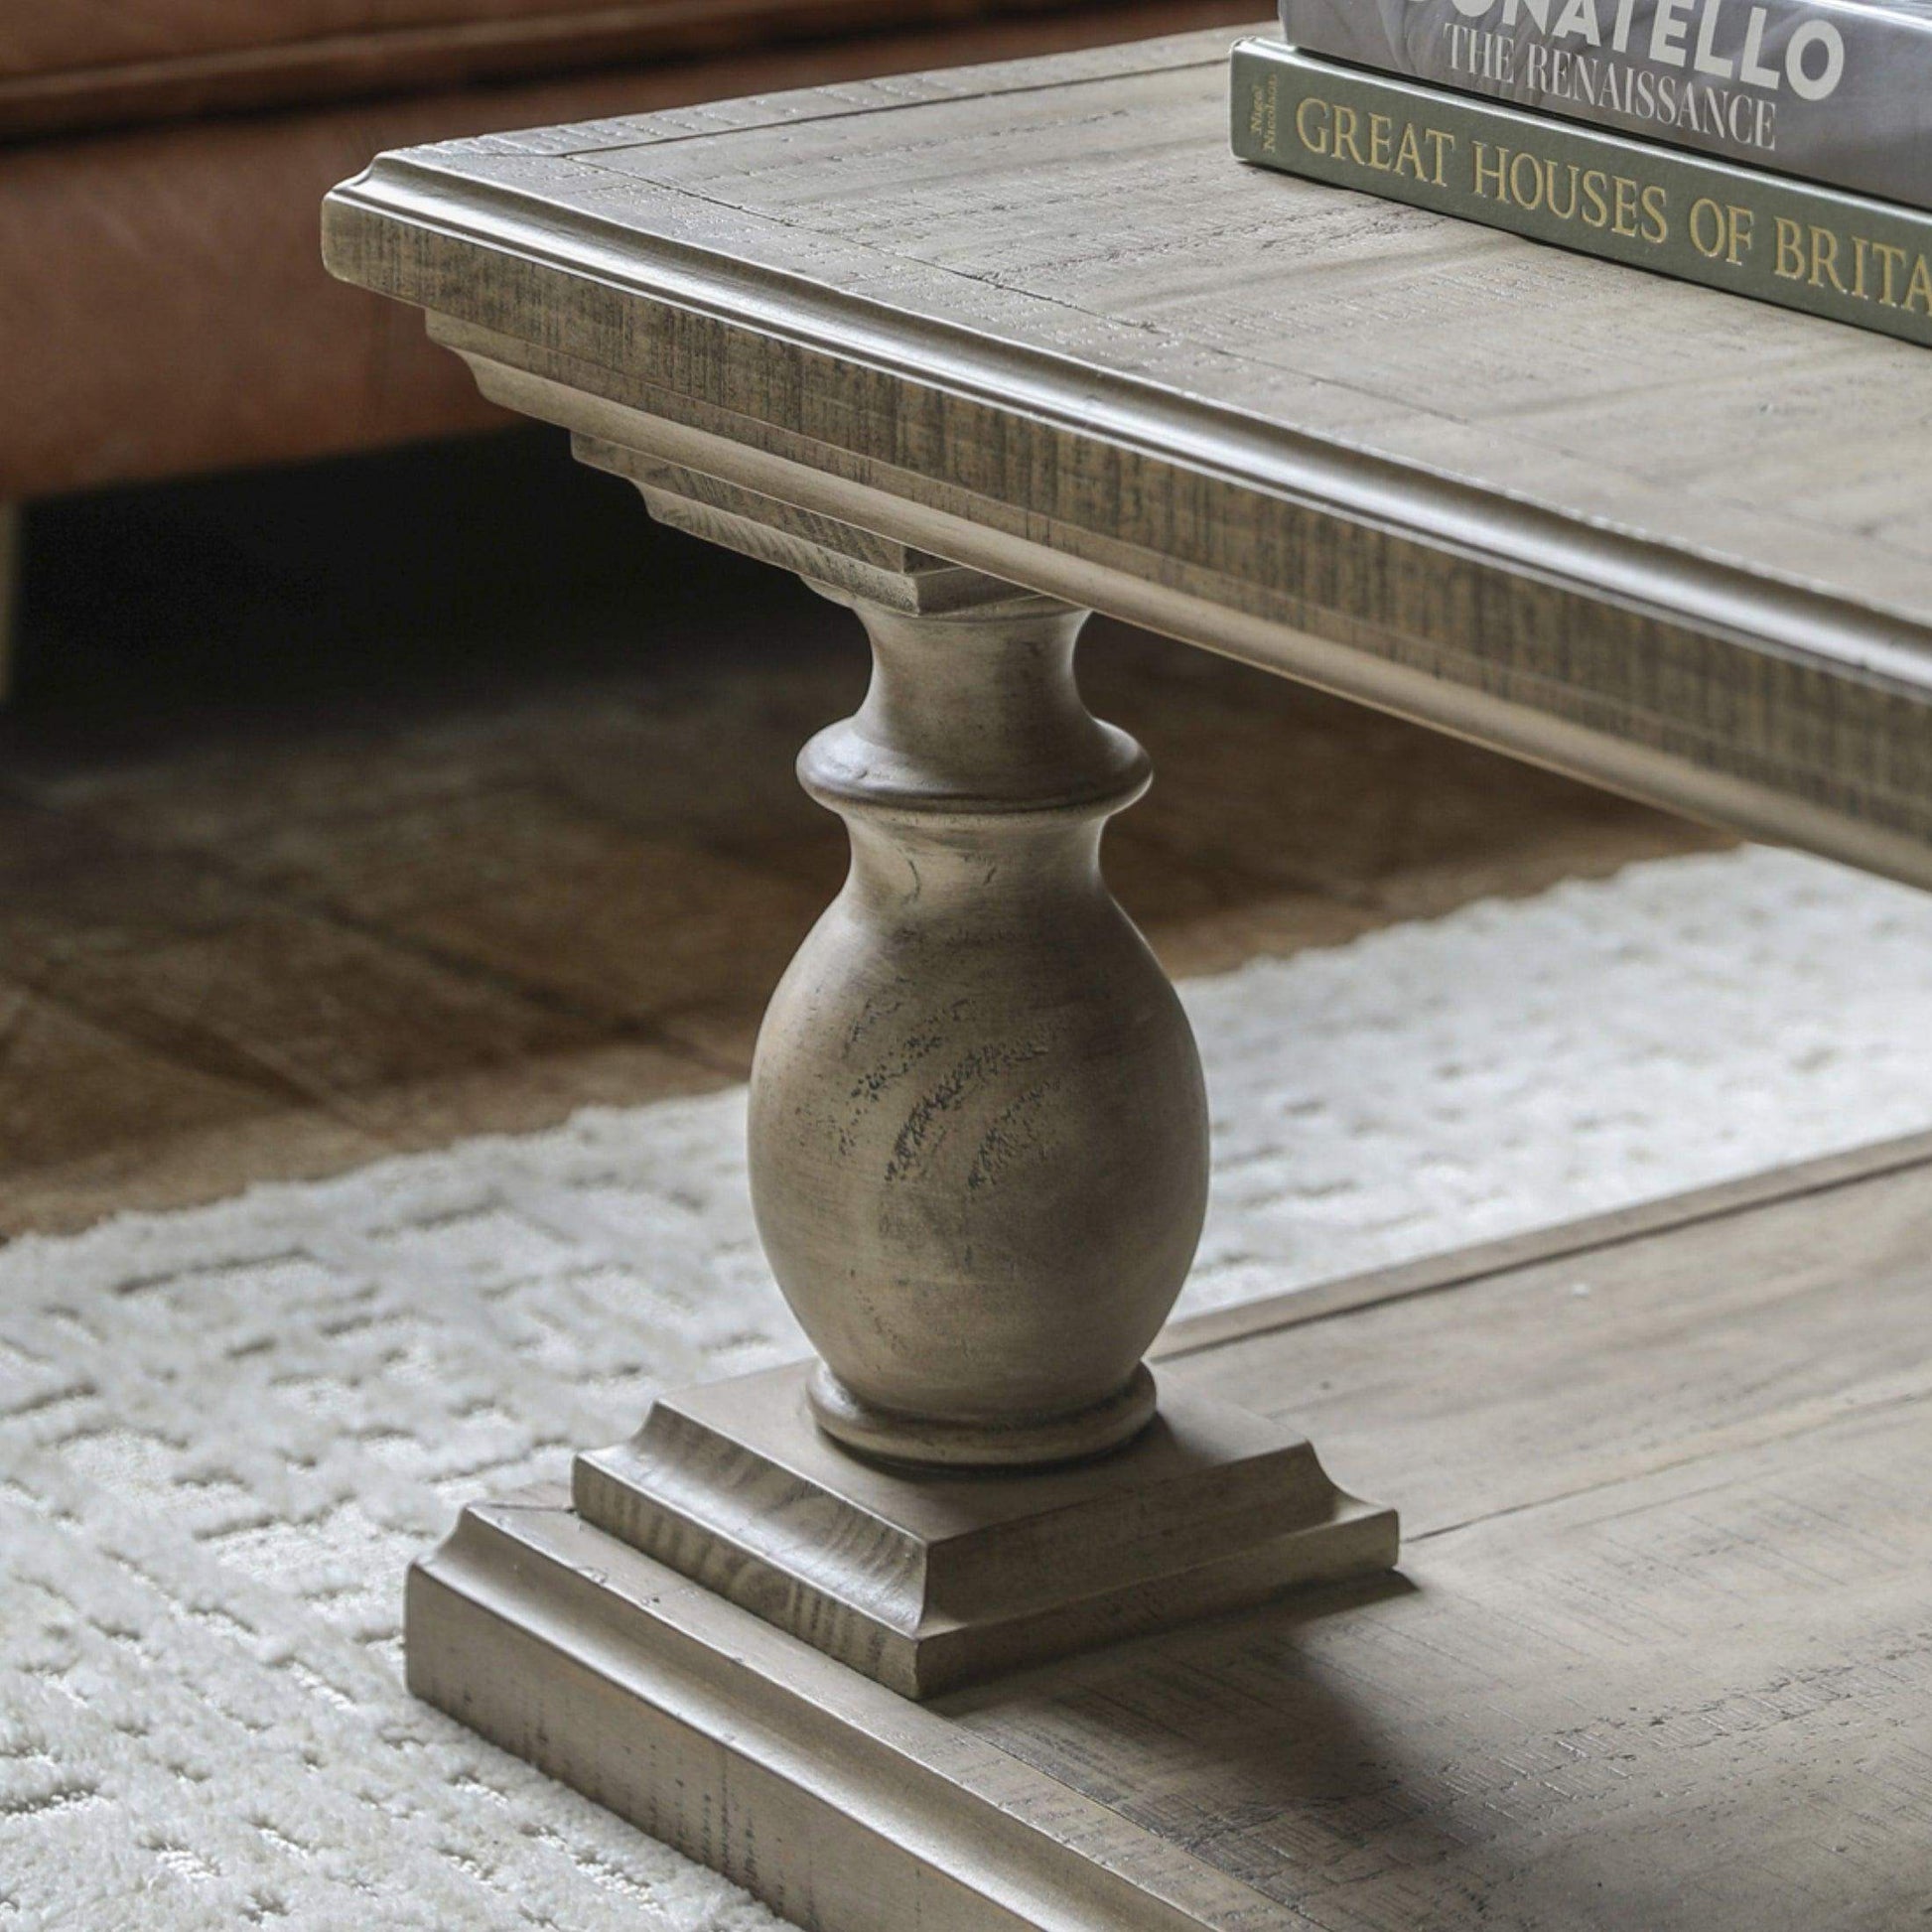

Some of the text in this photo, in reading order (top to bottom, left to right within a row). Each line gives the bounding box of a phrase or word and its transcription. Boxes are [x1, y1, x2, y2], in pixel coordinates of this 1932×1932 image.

[1408, 0, 1845, 100] ATELLO
[1443, 22, 1776, 151] THE RENAISSANCE
[1296, 97, 1932, 317] GREAT HOUSES OF BRITA
